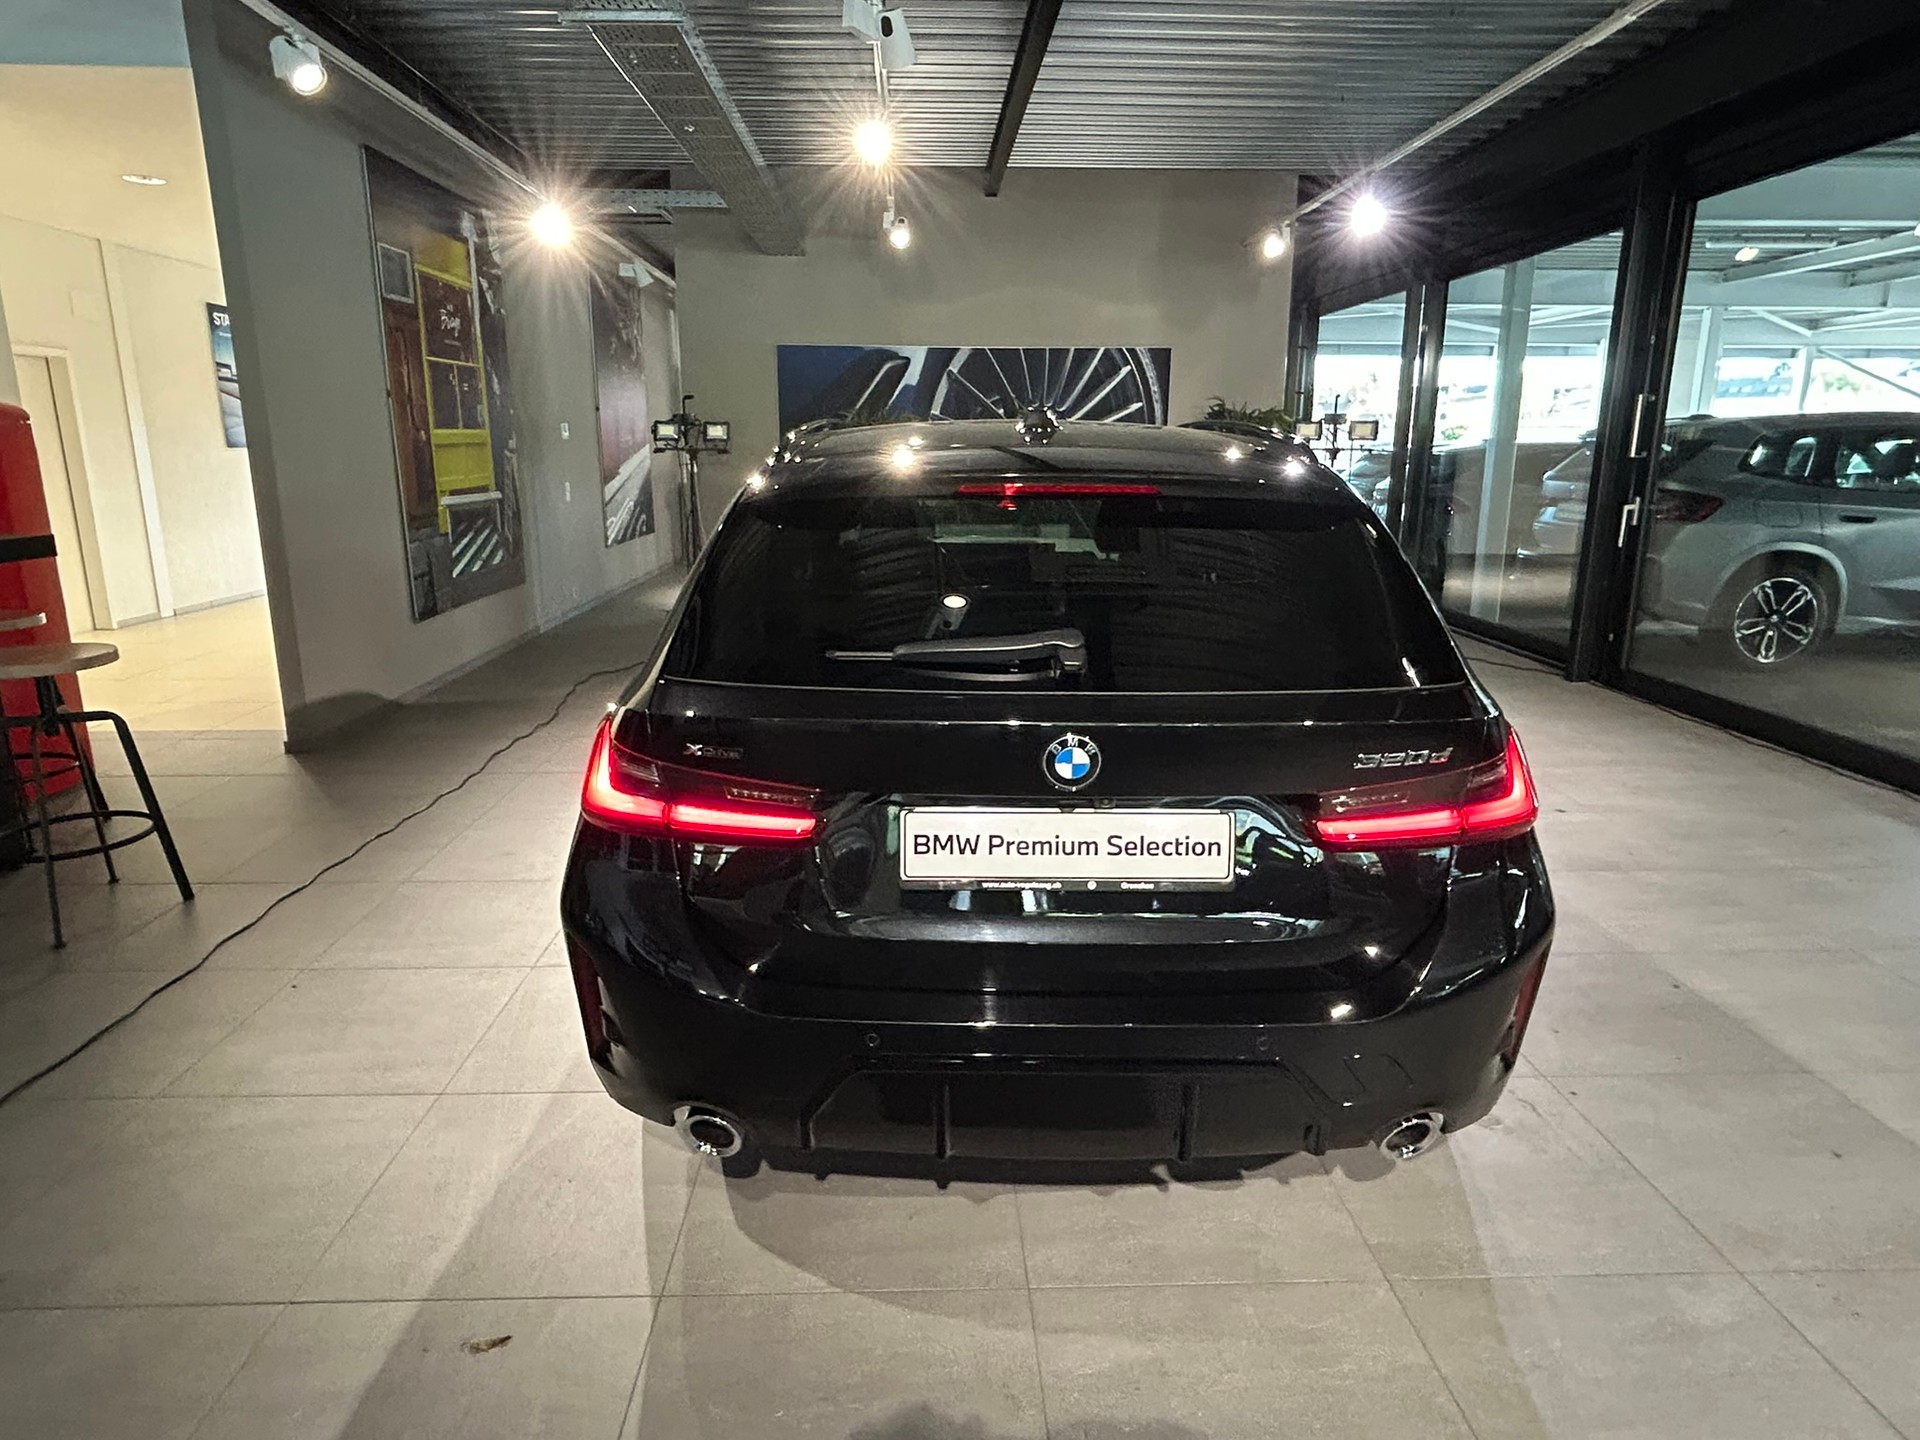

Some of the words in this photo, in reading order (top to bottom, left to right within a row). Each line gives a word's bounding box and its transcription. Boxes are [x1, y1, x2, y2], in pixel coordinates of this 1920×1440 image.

[1353, 747, 1453, 769] 320d
[913, 834, 980, 855] BMW
[988, 834, 1099, 857] Premium
[1106, 835, 1222, 857] Selection
